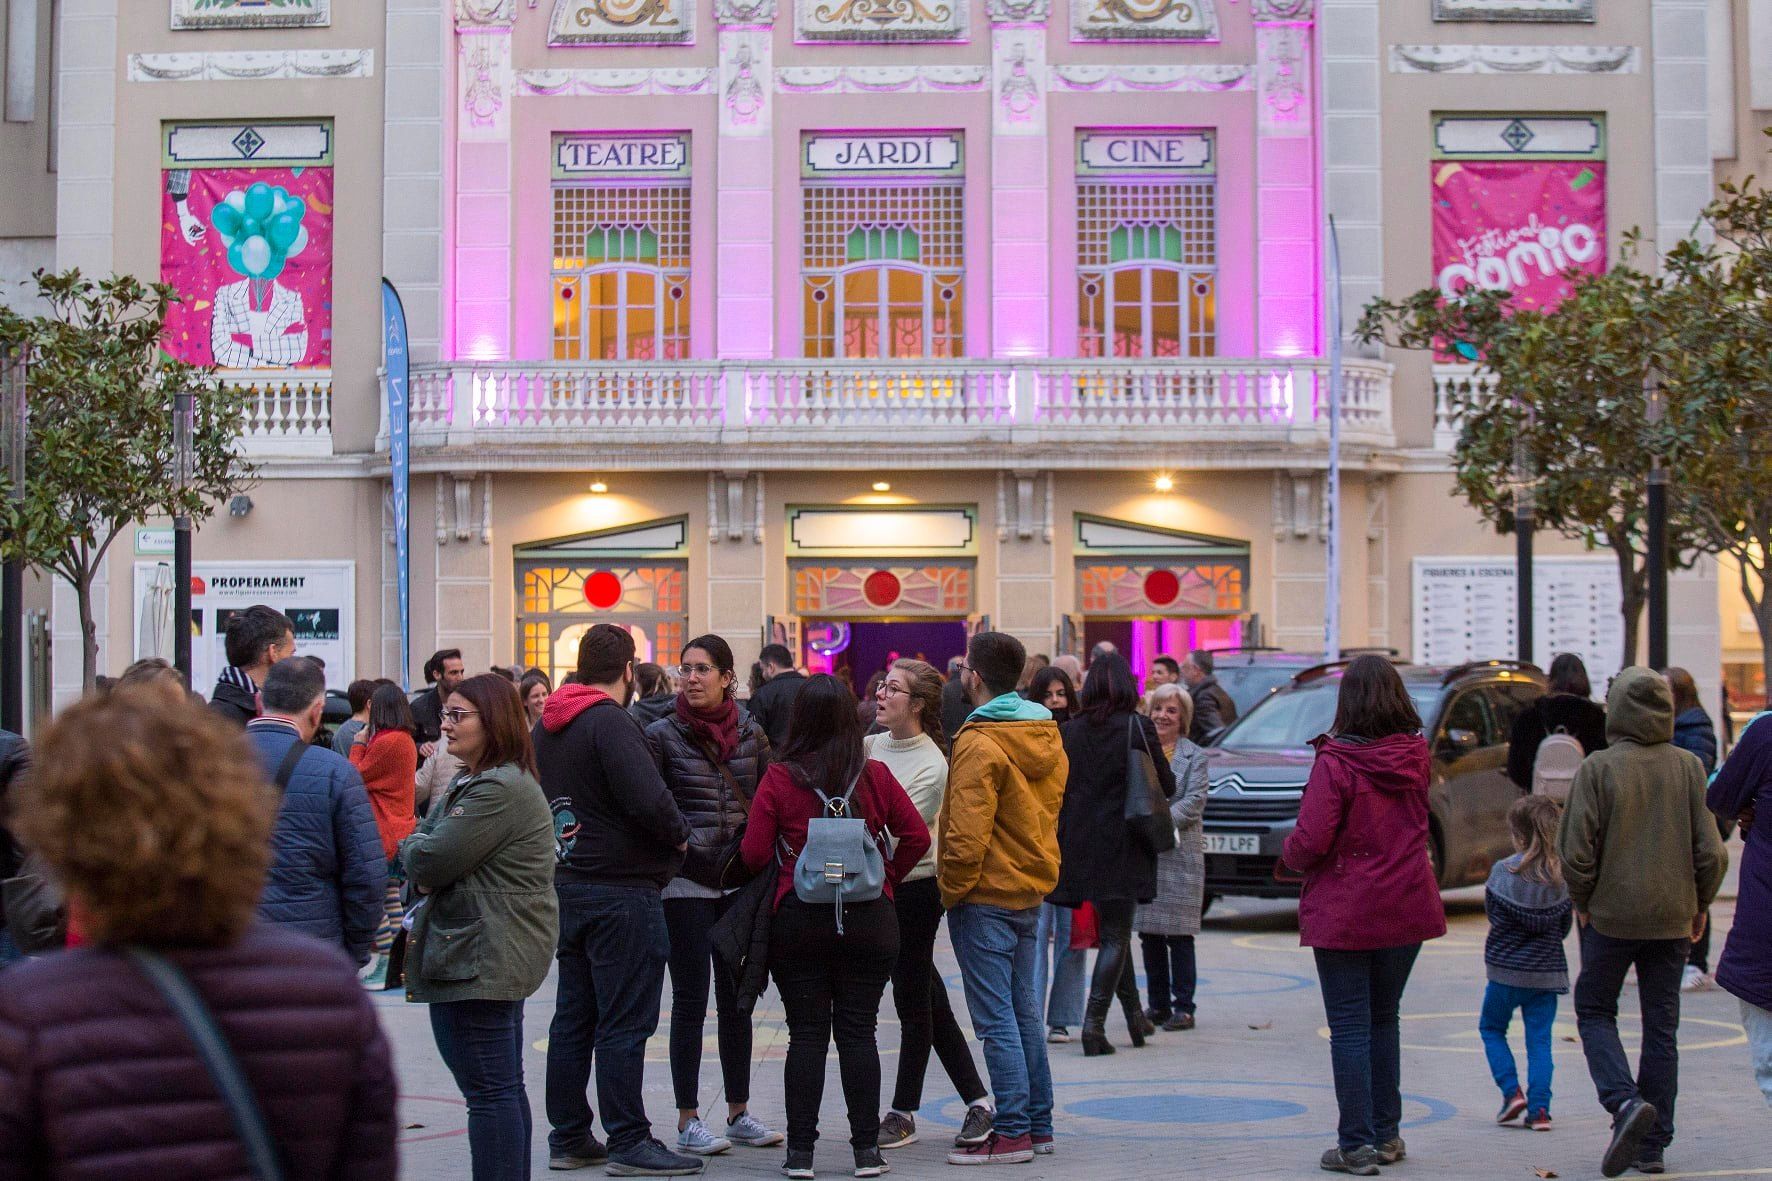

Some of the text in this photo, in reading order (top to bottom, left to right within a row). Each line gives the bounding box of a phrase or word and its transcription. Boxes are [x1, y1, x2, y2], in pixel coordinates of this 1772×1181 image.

[566, 142, 678, 166] TEATRE
[835, 139, 932, 165] JARDÍ
[1107, 140, 1184, 162] CINE
[211, 576, 305, 588] PROPERAMENT
[1229, 837, 1255, 852] LPF
